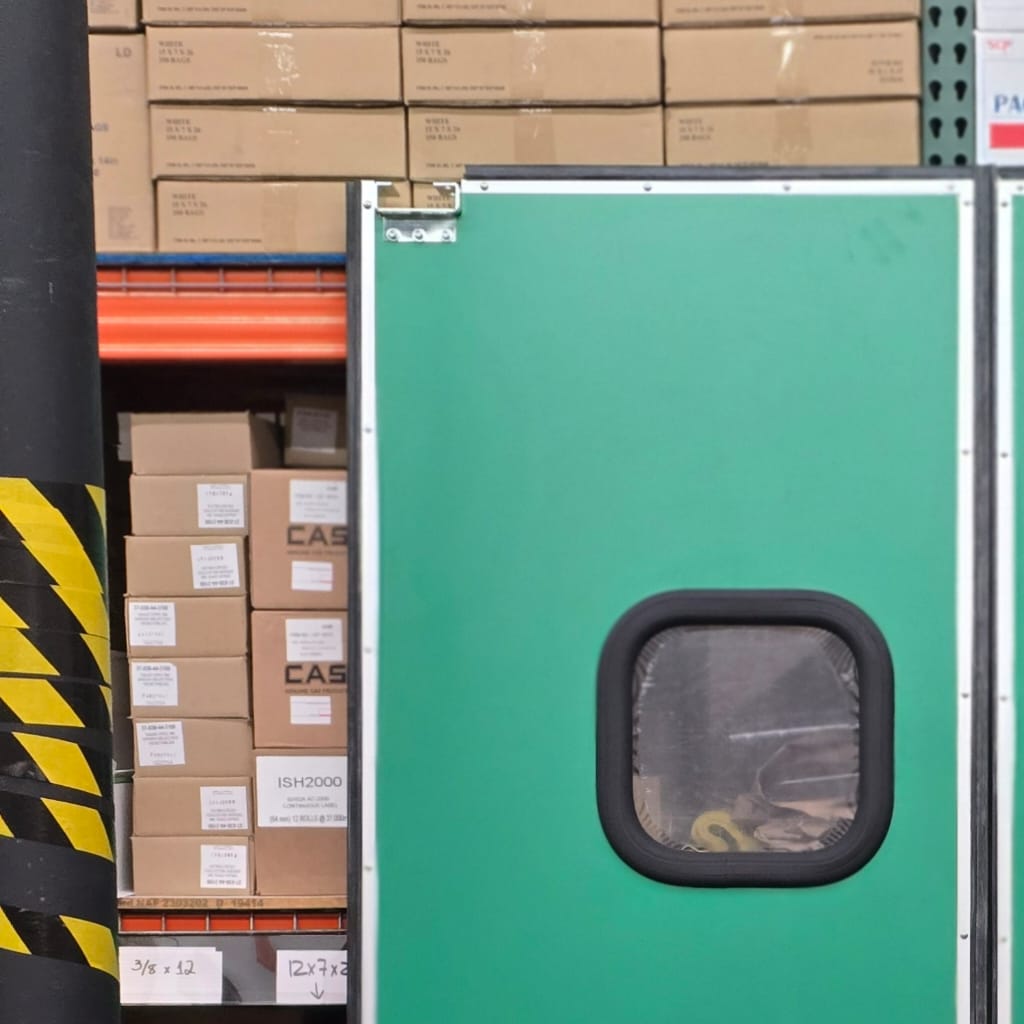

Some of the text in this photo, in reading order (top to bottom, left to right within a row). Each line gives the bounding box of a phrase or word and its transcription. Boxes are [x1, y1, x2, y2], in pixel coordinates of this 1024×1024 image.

[287, 526, 348, 546] CAS
[285, 664, 346, 684] CAS
[278, 776, 342, 789] ISH2000
[131, 959, 156, 976] 3/8
[176, 960, 196, 975] 12
